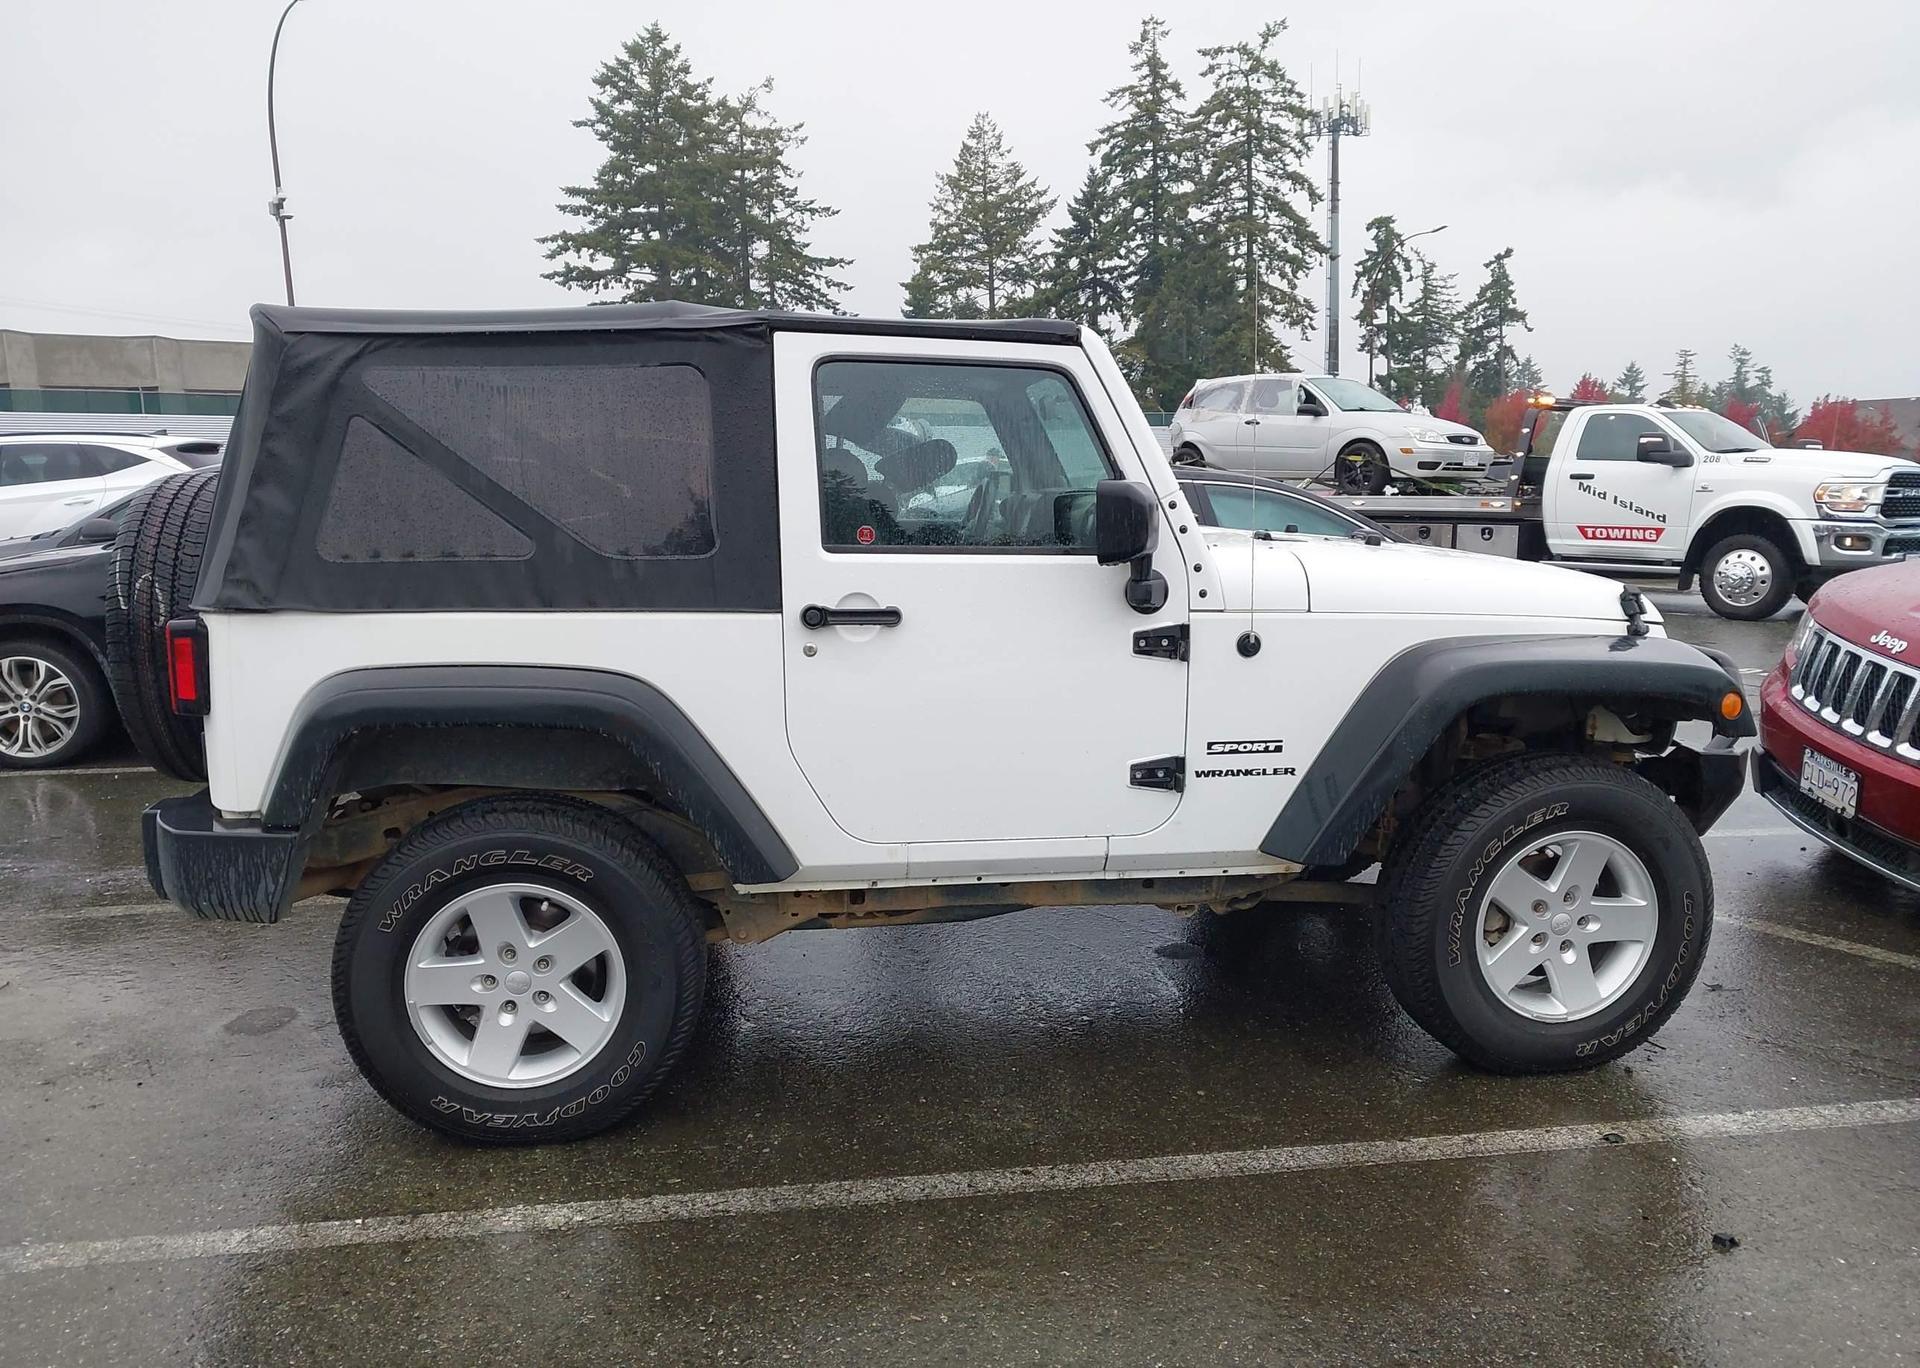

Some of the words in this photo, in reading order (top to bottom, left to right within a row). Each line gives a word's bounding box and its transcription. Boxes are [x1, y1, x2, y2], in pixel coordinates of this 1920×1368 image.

[1703, 455, 1721, 463] 208
[1578, 481, 1607, 500] Mid
[1613, 495, 1666, 523] Island
[1584, 527, 1657, 540] TOWING
[1870, 630, 1908, 654] Jeep
[1207, 741, 1283, 754] SPORT
[1194, 767, 1296, 778] WRANGLER
[378, 850, 594, 933] WRANGLER
[1449, 802, 1570, 967] WRANGLER
[1576, 890, 1695, 1057] GOODYEAR
[430, 1041, 647, 1128] GOODYEAR
